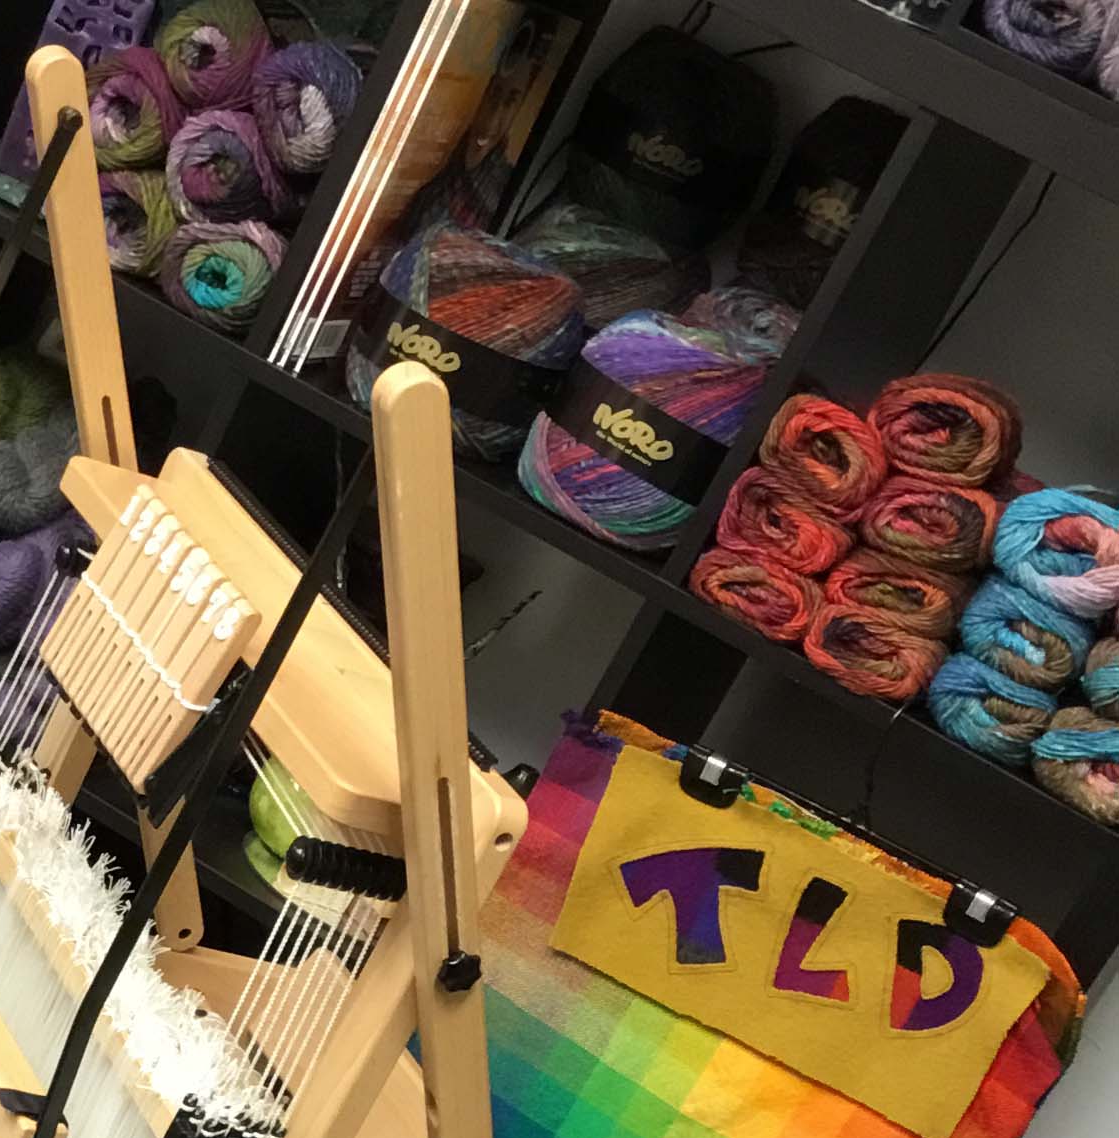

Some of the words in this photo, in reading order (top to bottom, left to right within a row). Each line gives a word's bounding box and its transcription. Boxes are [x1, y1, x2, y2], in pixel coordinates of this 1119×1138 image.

[387, 321, 461, 373] NORO
[592, 403, 674, 461] NORO
[620, 846, 984, 1032] TLD
